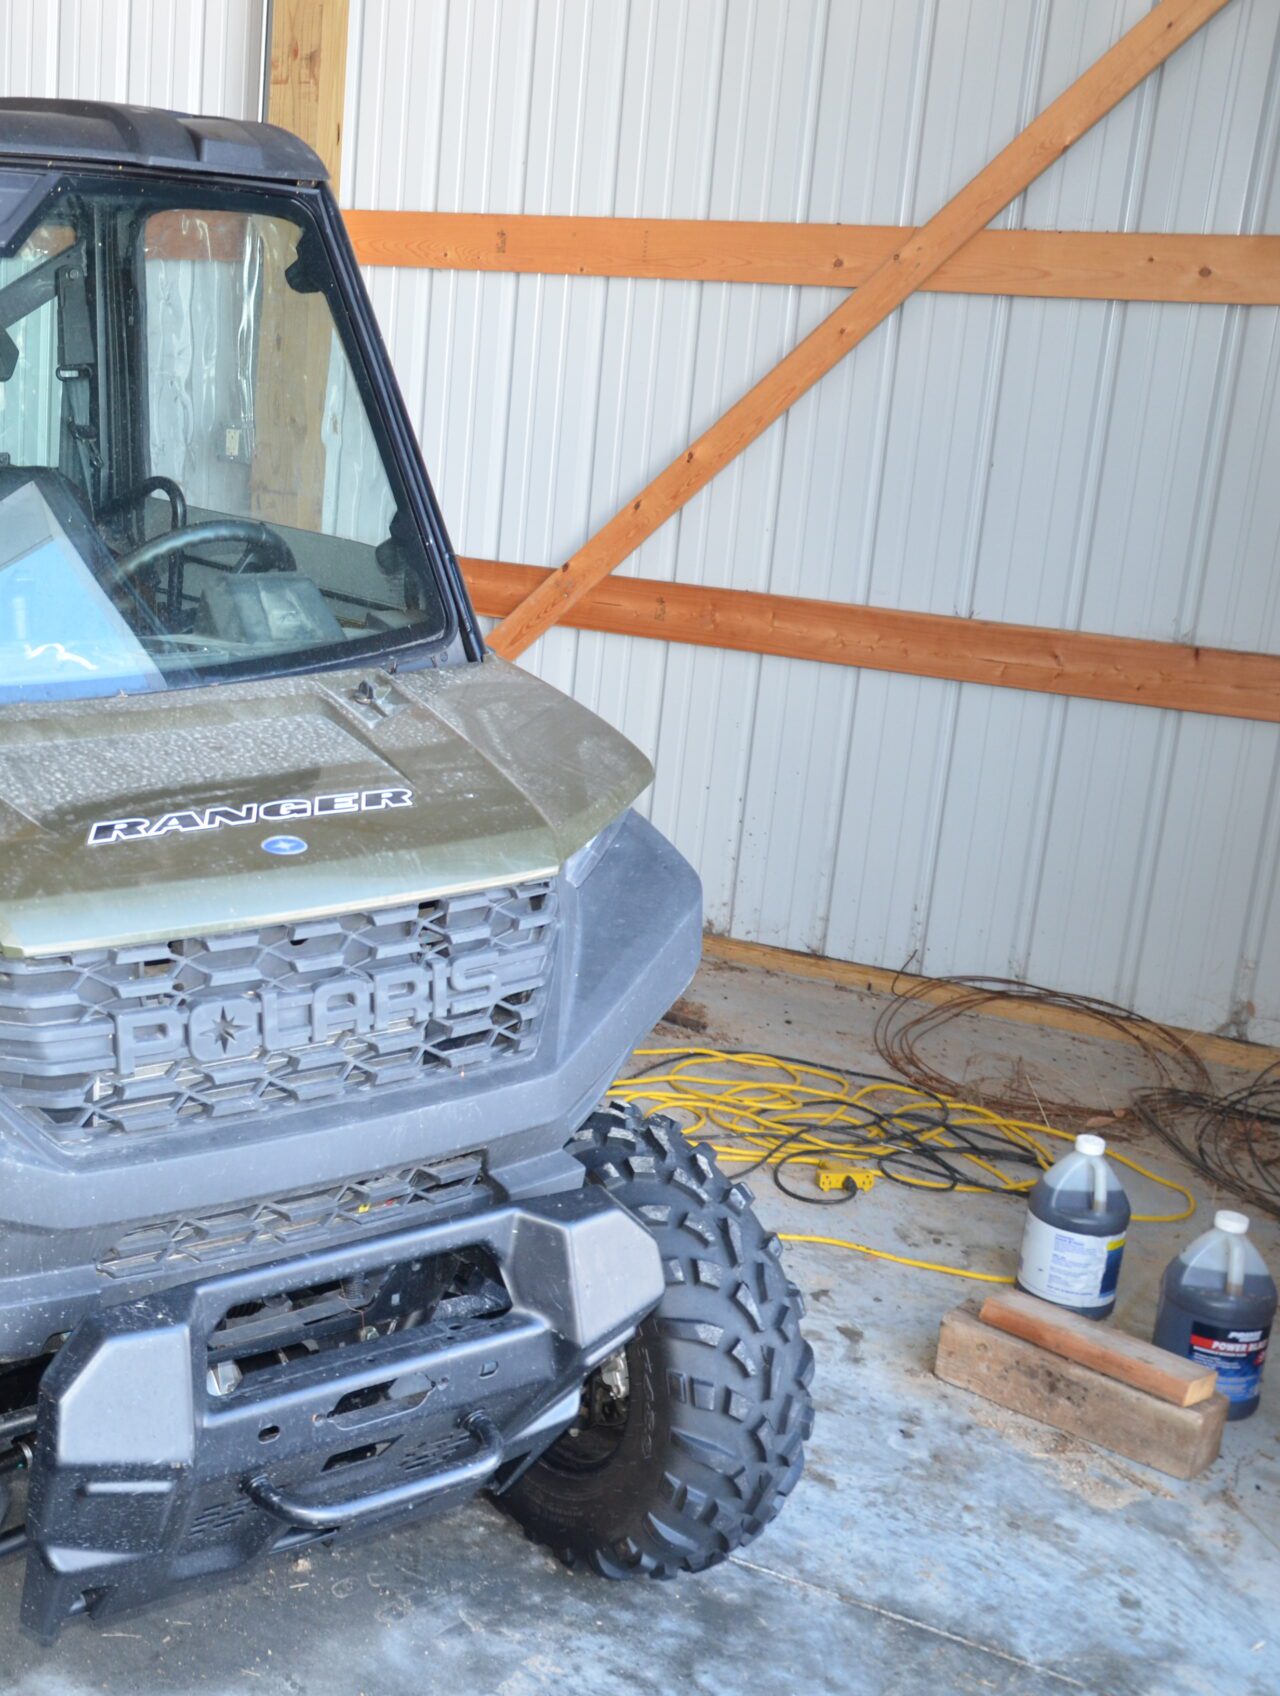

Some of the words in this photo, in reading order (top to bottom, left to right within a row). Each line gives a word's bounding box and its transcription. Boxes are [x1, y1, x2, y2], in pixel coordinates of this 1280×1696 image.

[87, 788, 414, 845] RANGER
[114, 950, 502, 1076] POLARIS
[1211, 1340, 1248, 1353] POWER
